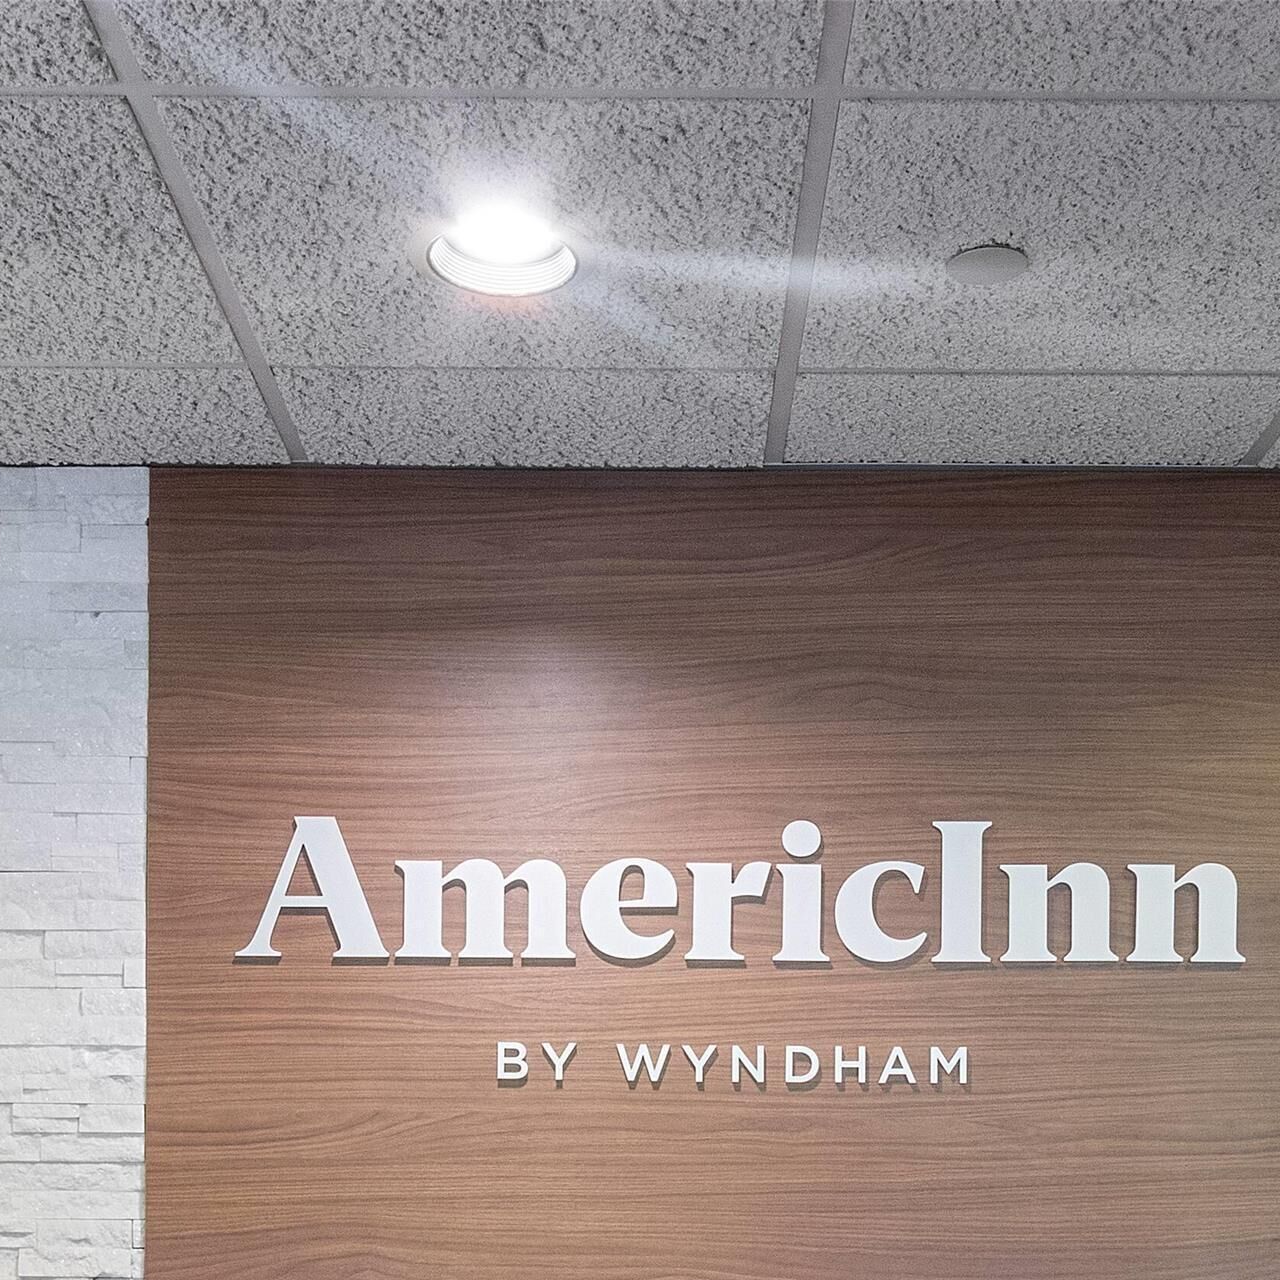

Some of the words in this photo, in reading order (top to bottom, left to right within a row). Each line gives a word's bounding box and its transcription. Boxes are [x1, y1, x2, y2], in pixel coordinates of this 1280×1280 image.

[234, 815, 1246, 964] AmericInn
[496, 1042, 578, 1082] BY
[617, 1043, 971, 1085] WYNDHAM
